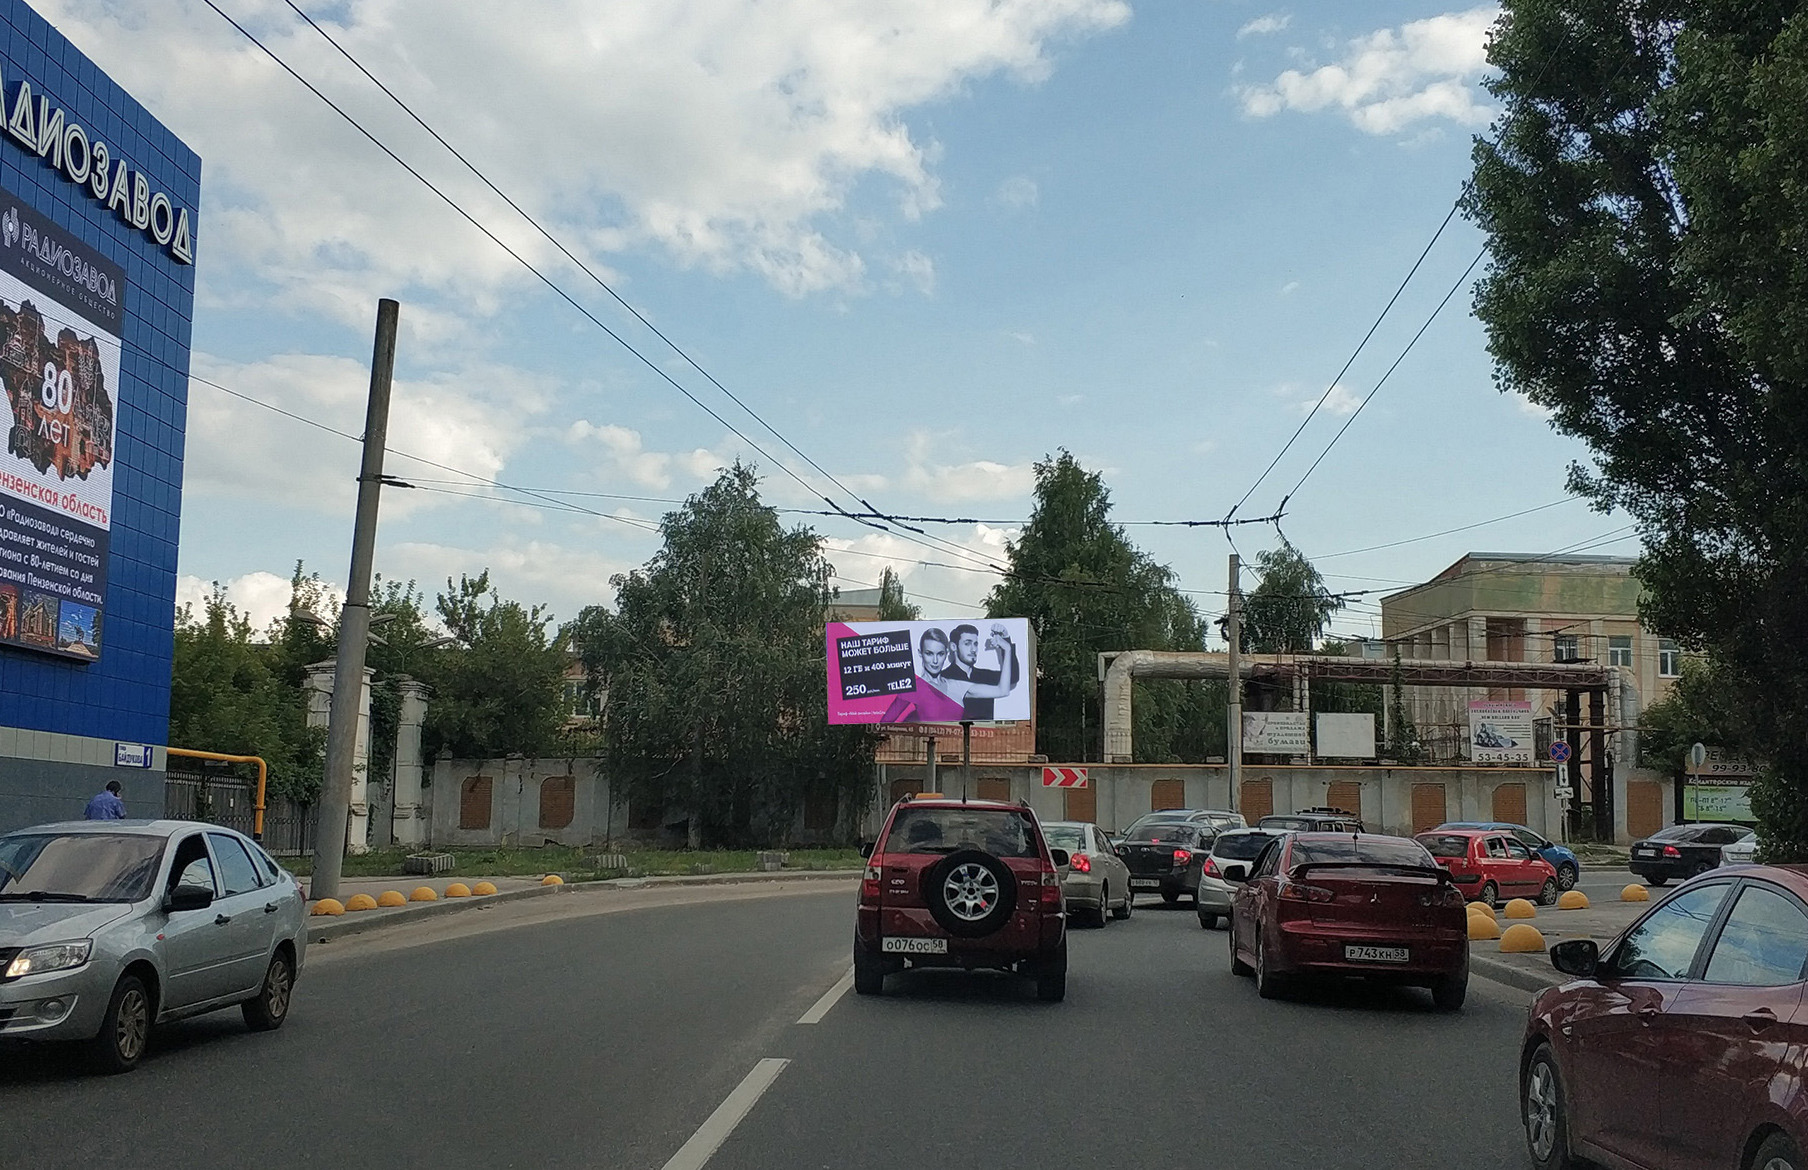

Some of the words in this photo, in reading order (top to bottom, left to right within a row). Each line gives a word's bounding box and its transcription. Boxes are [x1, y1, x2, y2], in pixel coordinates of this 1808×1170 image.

[0, 62, 192, 265] ДИОЗАВОД
[22, 222, 117, 306] РАДИОЗАВОД
[20, 257, 76, 296] АКЦИОНЕРНОЕ
[79, 292, 116, 320] ОБЩЕСТВО
[41, 362, 73, 415] 80
[37, 415, 70, 448] лет
[62, 495, 107, 524] область
[7, 509, 59, 536] «Радиозавод»
[60, 528, 96, 548] сердечно
[36, 539, 68, 559] жителей
[69, 550, 74, 560] и
[75, 552, 100, 568] гостей
[23, 555, 29, 565] с
[30, 554, 69, 577] 80-летием
[70, 569, 80, 580] со
[80, 572, 93, 584] дня
[27, 572, 72, 596] Пензенской
[840, 639, 860, 649] НАШ
[861, 636, 890, 647] ТАРИФ
[841, 647, 872, 658] МОЖЕТ
[873, 642, 909, 654] БОЛЬШЕ
[843, 665, 853, 675] 12
[853, 664, 863, 674] ГБ
[871, 662, 885, 671] 400
[886, 660, 911, 669] минут
[845, 684, 867, 696] 250
[887, 677, 912, 691] TELE2
[1267, 737, 1306, 746] бумаги
[146, 748, 151, 766] 1
[1477, 753, 1529, 762] 53-45-35
